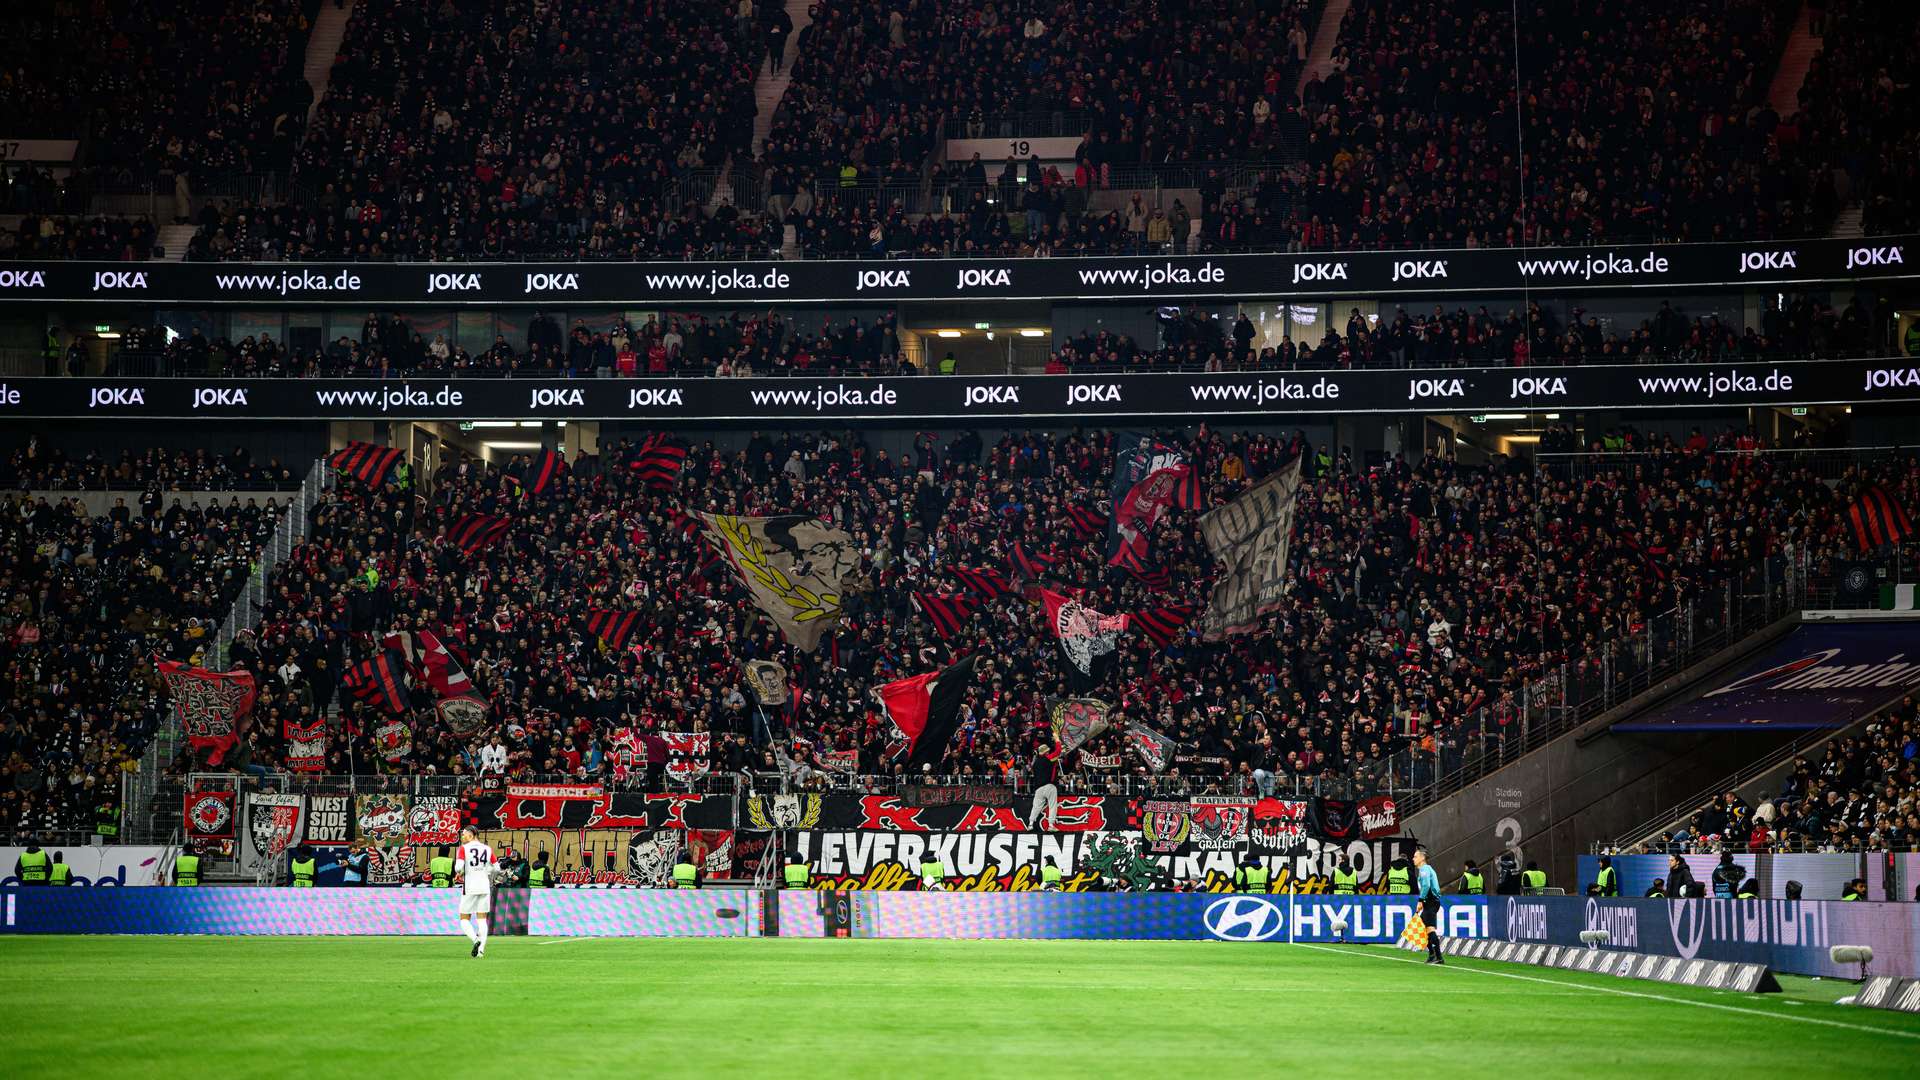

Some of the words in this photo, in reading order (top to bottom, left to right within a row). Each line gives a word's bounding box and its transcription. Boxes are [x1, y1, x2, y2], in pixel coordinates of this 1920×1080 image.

[1010, 141, 1030, 156] 19
[1518, 252, 1668, 280] www.joka.de
[1740, 251, 1796, 273] JOKA
[1847, 247, 1903, 269] JOKA
[93, 272, 147, 290] JOKA
[646, 268, 789, 294] www.joka.de
[856, 271, 910, 290] JOKA
[957, 269, 1011, 289] JOKA
[1079, 262, 1224, 289] www.joka.de
[1292, 263, 1347, 283] JOKA
[1392, 261, 1447, 281] JOKA
[216, 270, 360, 295] www.joka.de
[428, 274, 481, 293] JOKA
[525, 274, 578, 293] JOKA
[1409, 379, 1465, 400] JOKA
[1511, 378, 1567, 398] JOKA
[1639, 369, 1792, 398] www.joka.de
[1865, 369, 1920, 391] JOKA
[90, 388, 144, 407] JOKA
[193, 389, 247, 408] JOKA
[316, 385, 462, 411] www.joka.de
[530, 389, 584, 408] JOKA
[629, 389, 682, 408] JOKA
[751, 384, 896, 411] www.joka.de
[964, 386, 1019, 406] JOKA
[1067, 385, 1121, 405] JOKA
[1191, 377, 1338, 405] www.joka.de
[510, 786, 586, 797] OFFENBACH
[1496, 788, 1522, 797] Stadion
[311, 797, 348, 811] WEST
[1143, 801, 1190, 813] JUGEND
[1497, 799, 1521, 808] Tunnel
[310, 811, 347, 826] SIDE
[308, 826, 346, 841] BOYZ
[1251, 827, 1307, 856] Brothers
[796, 832, 1076, 878] LEVERKUSEN
[1152, 841, 1179, 852] LEV
[1494, 817, 1523, 877] 3
[469, 847, 487, 867] 34
[560, 868, 591, 884] mit
[1517, 904, 1548, 940] HYUNDAI
[1600, 906, 1638, 948] HYUNDAI
